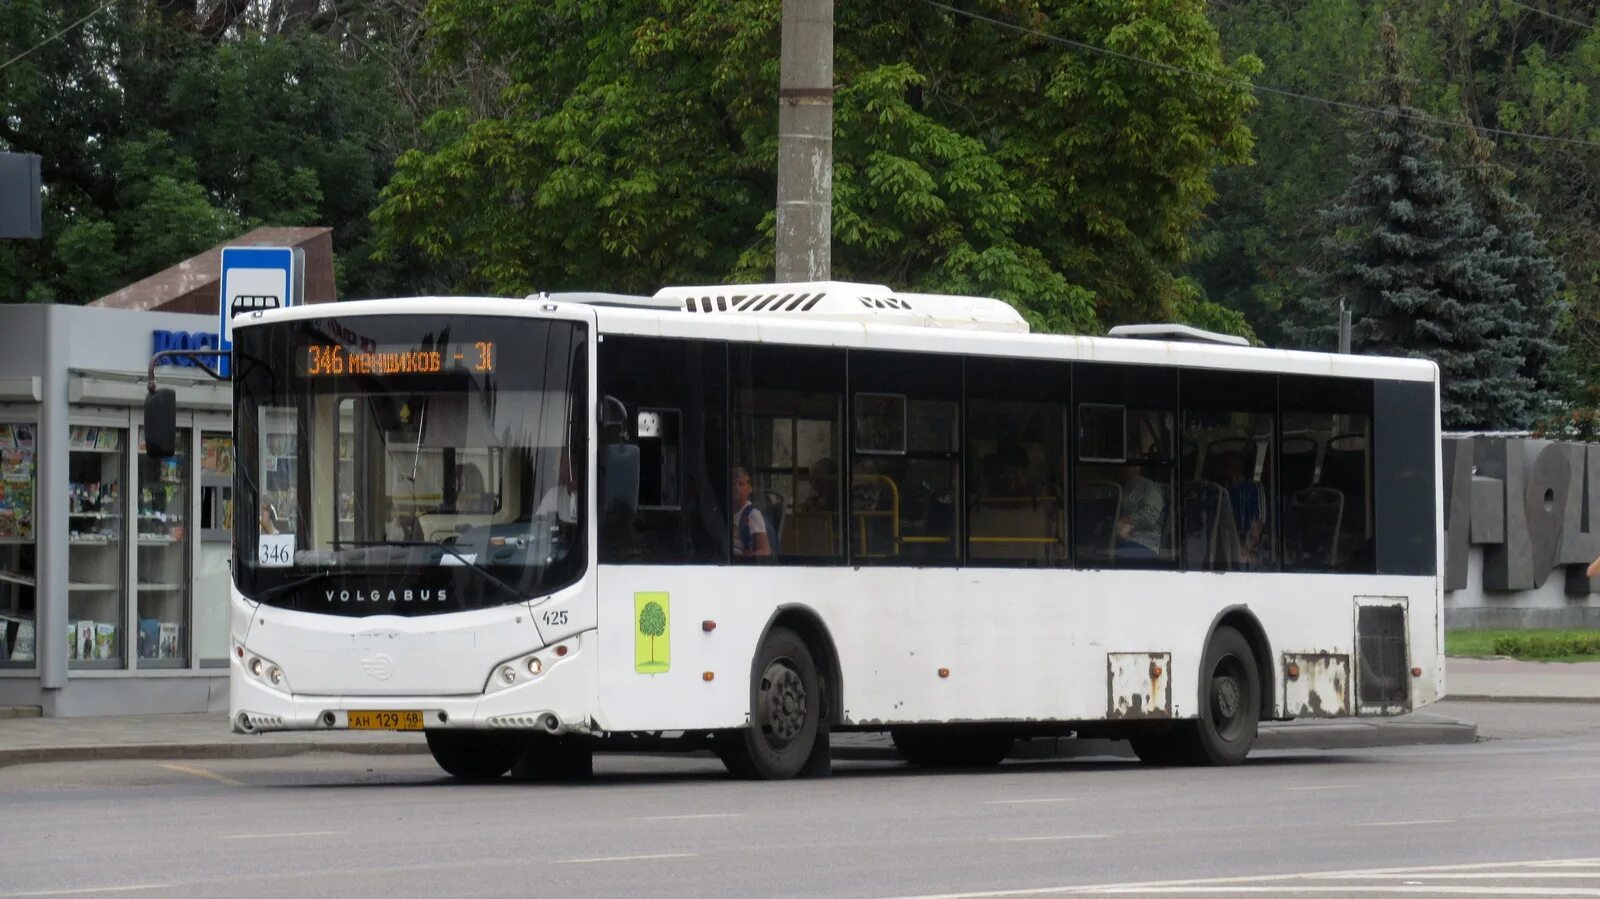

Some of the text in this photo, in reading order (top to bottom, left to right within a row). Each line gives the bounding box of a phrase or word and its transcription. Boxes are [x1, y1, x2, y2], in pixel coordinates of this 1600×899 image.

[308, 345, 343, 374] 346
[262, 543, 289, 564] 346
[325, 589, 447, 602] VOLGABUS
[542, 610, 569, 625] 425
[376, 713, 399, 728] 129
[406, 713, 418, 723] 48
